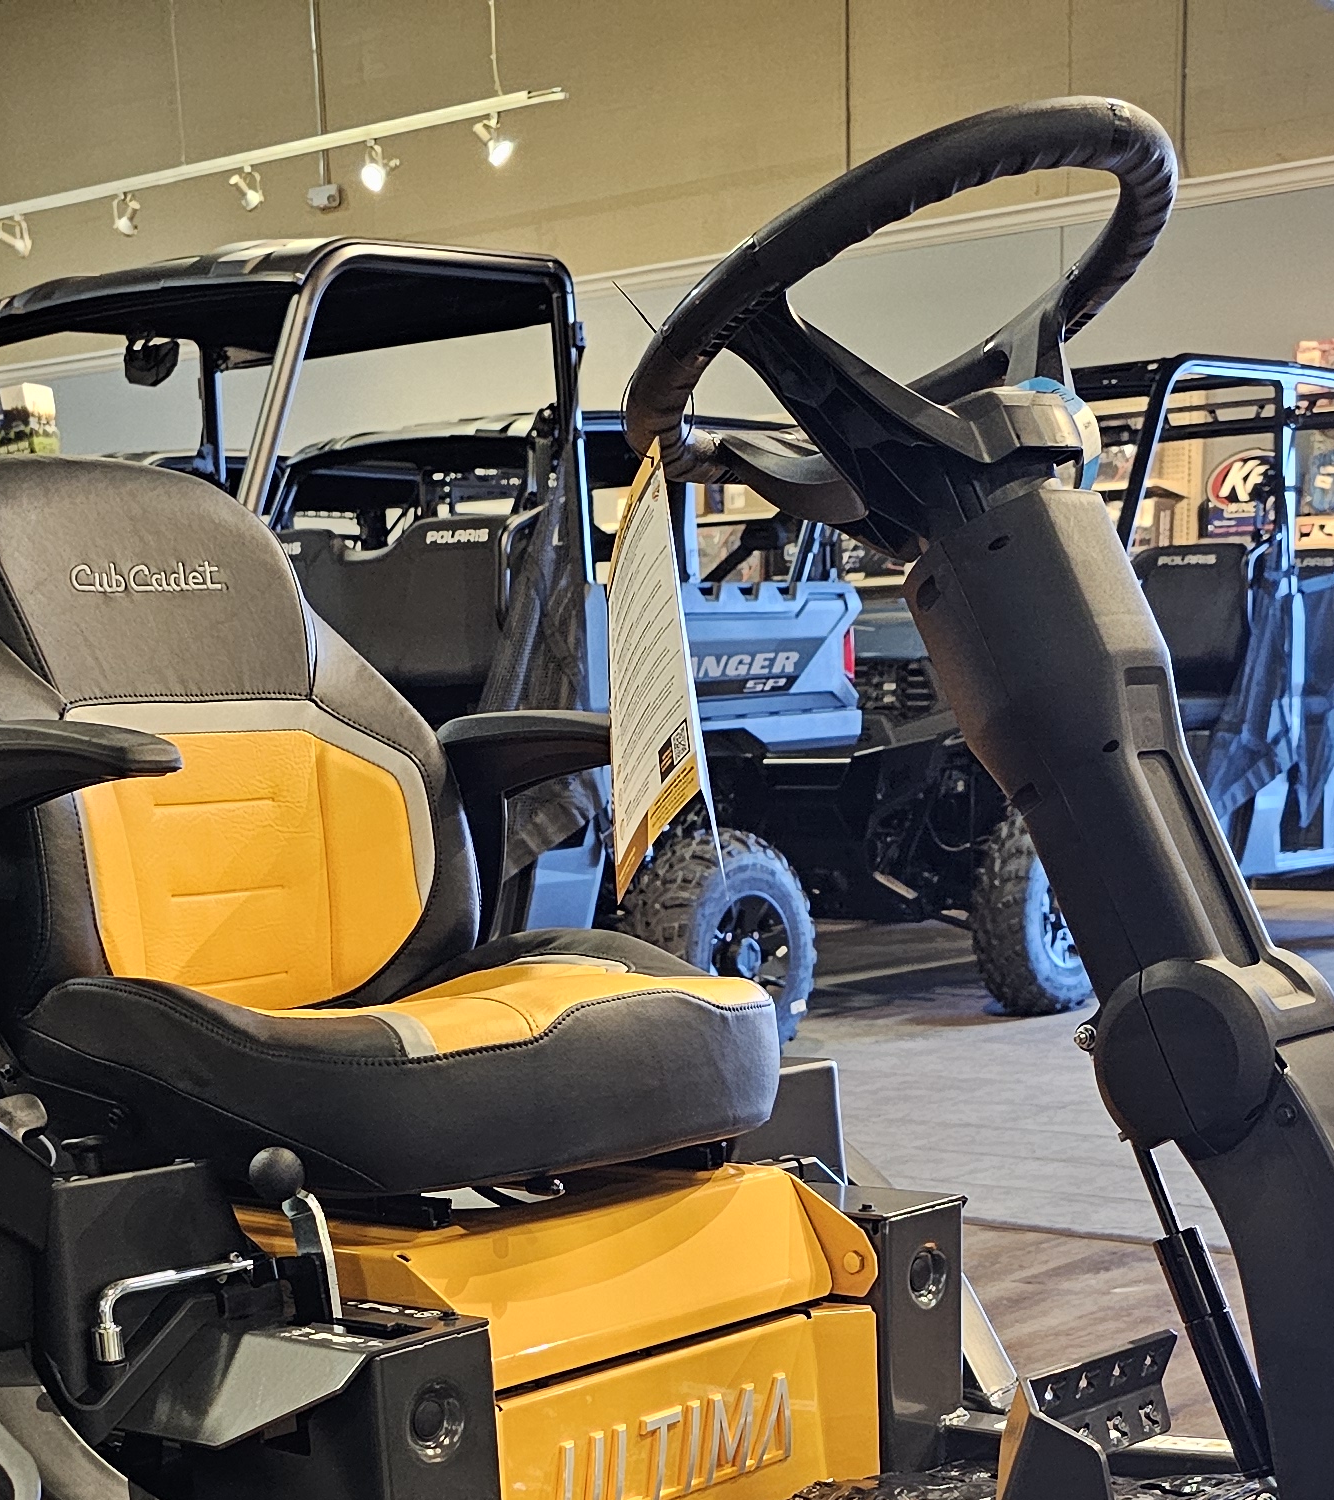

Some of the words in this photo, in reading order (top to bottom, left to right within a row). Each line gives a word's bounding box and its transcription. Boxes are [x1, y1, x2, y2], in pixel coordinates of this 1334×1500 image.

[1218, 460, 1271, 502] KF
[426, 528, 489, 544] POLARIS
[1157, 554, 1217, 567] POLARIS
[1295, 557, 1334, 568] LARIS
[70, 561, 128, 593] Cub
[128, 560, 223, 593] Cadet
[691, 651, 800, 678] NGER
[743, 677, 787, 693] SP
